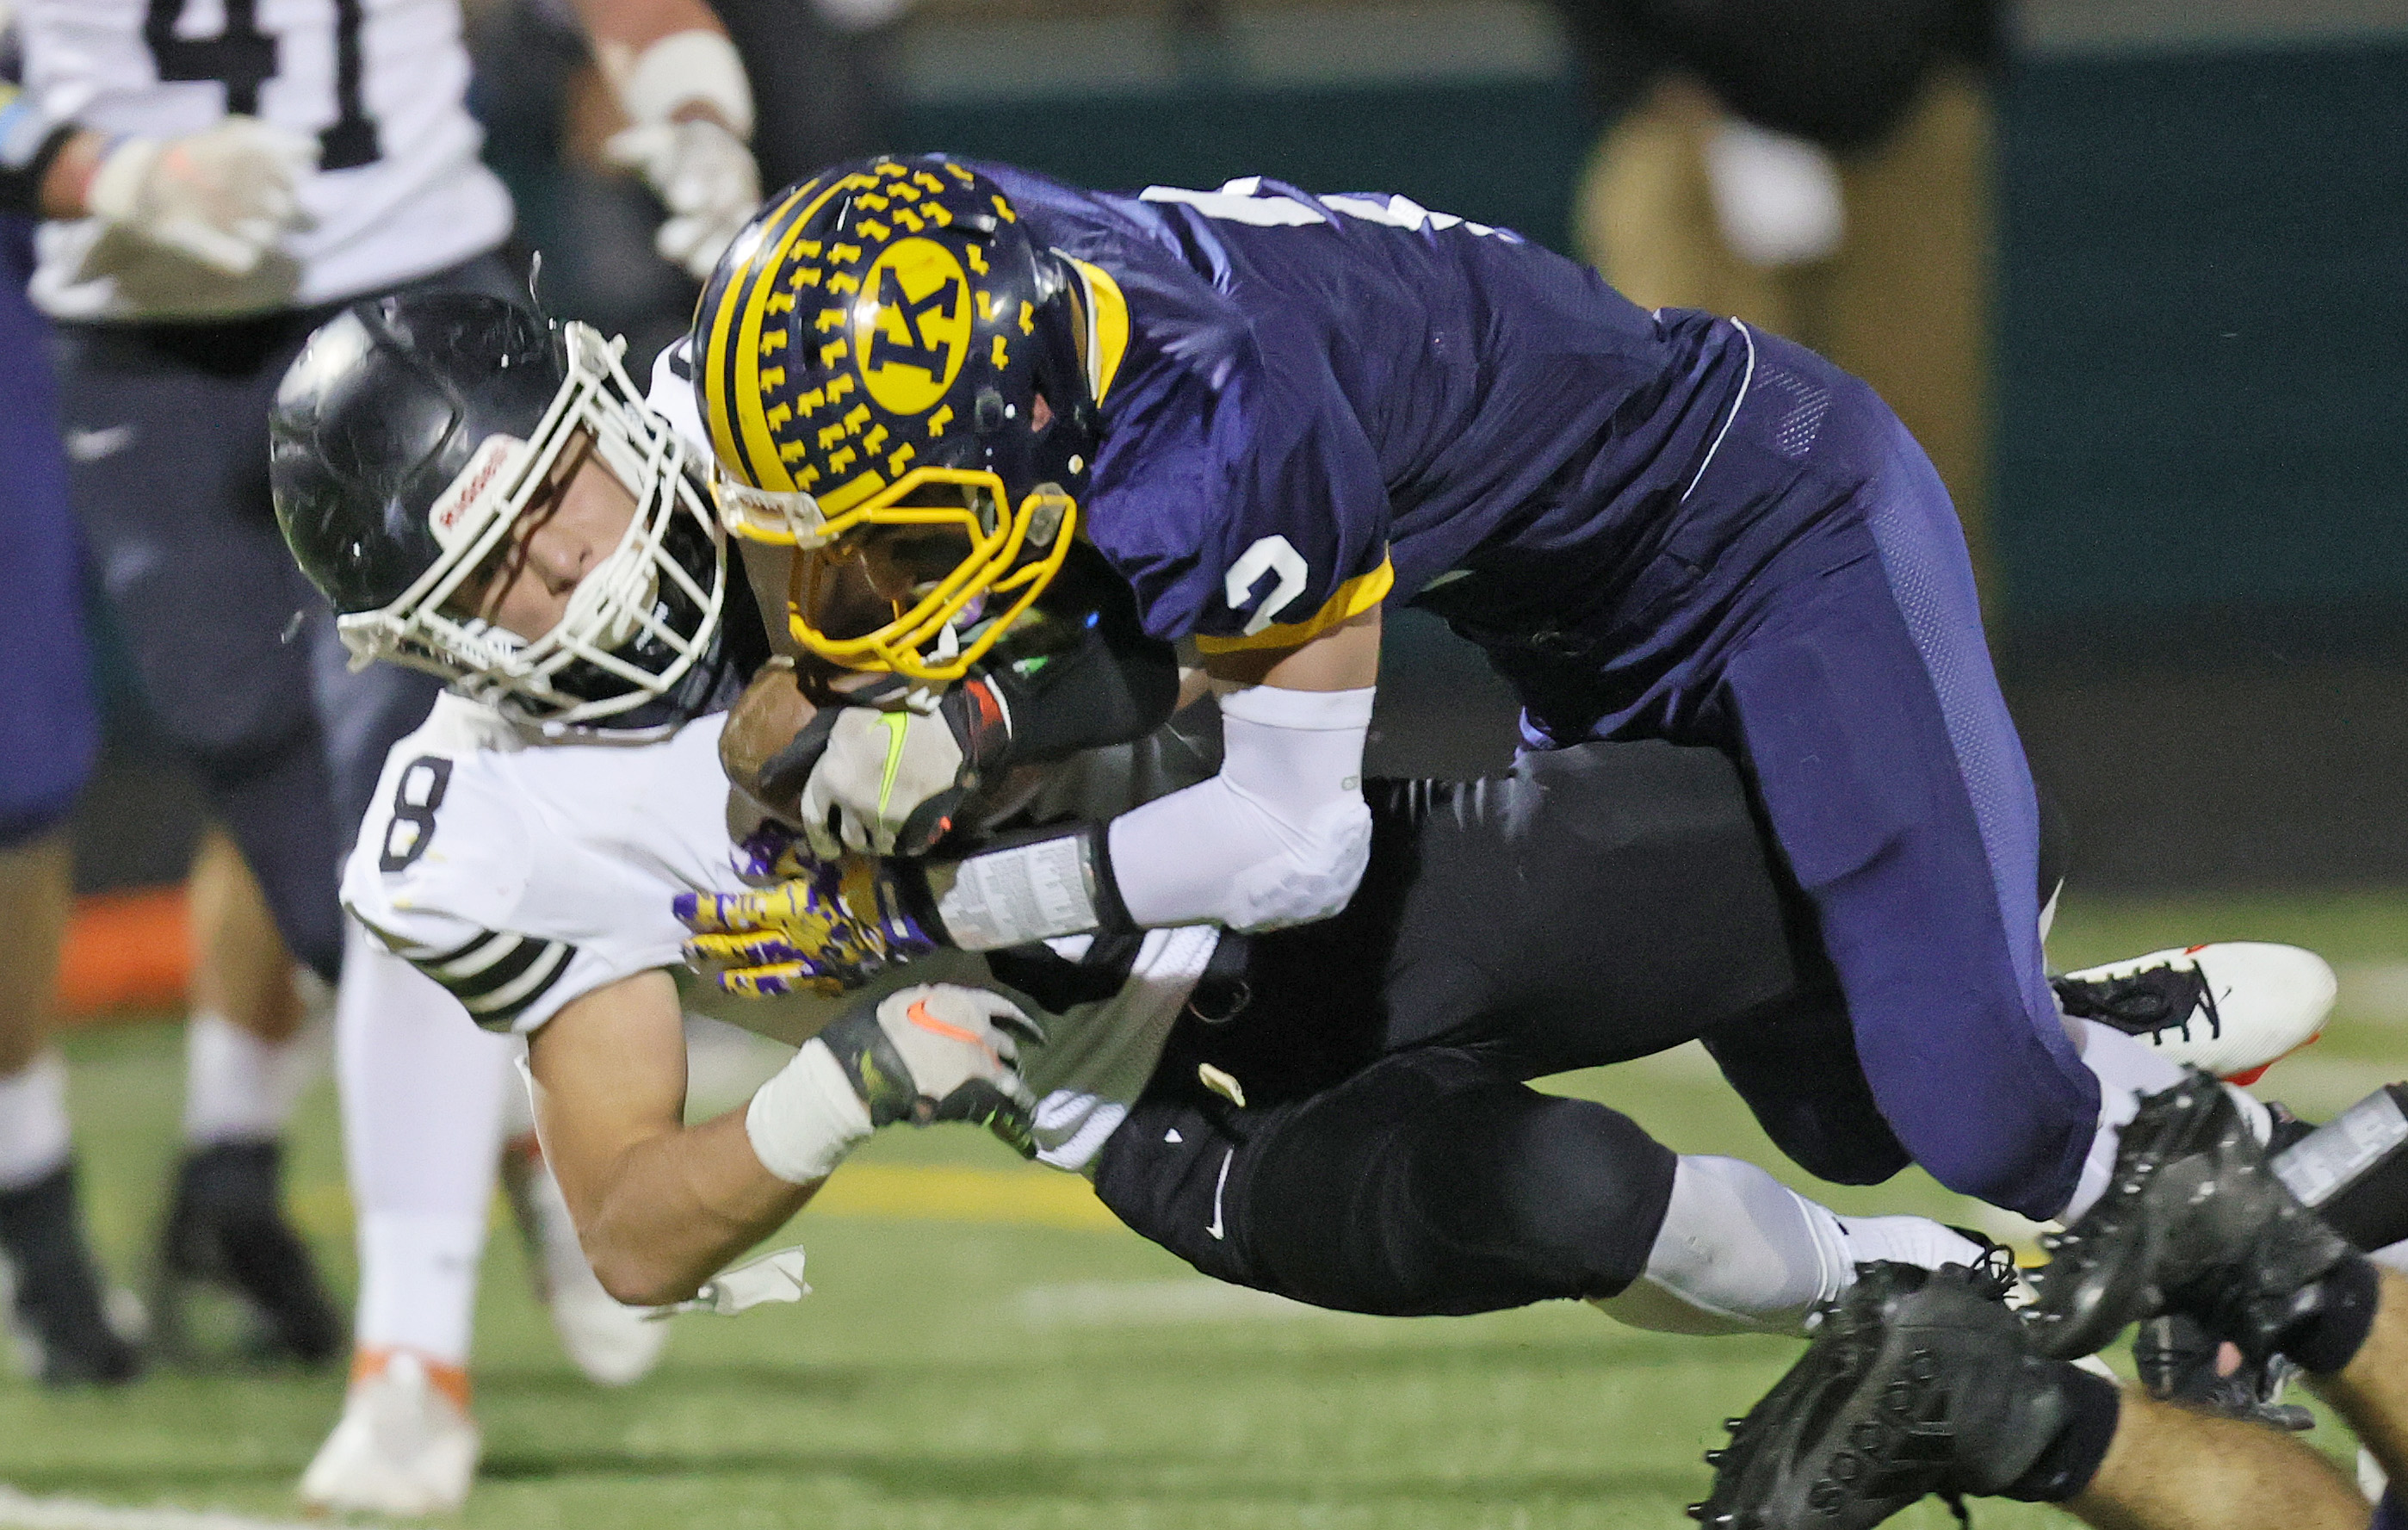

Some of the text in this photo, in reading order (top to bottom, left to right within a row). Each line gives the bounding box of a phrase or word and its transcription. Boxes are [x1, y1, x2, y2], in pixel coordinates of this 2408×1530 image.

[144, 0, 381, 172] 41
[868, 265, 959, 384] K
[379, 755, 454, 872] 8
